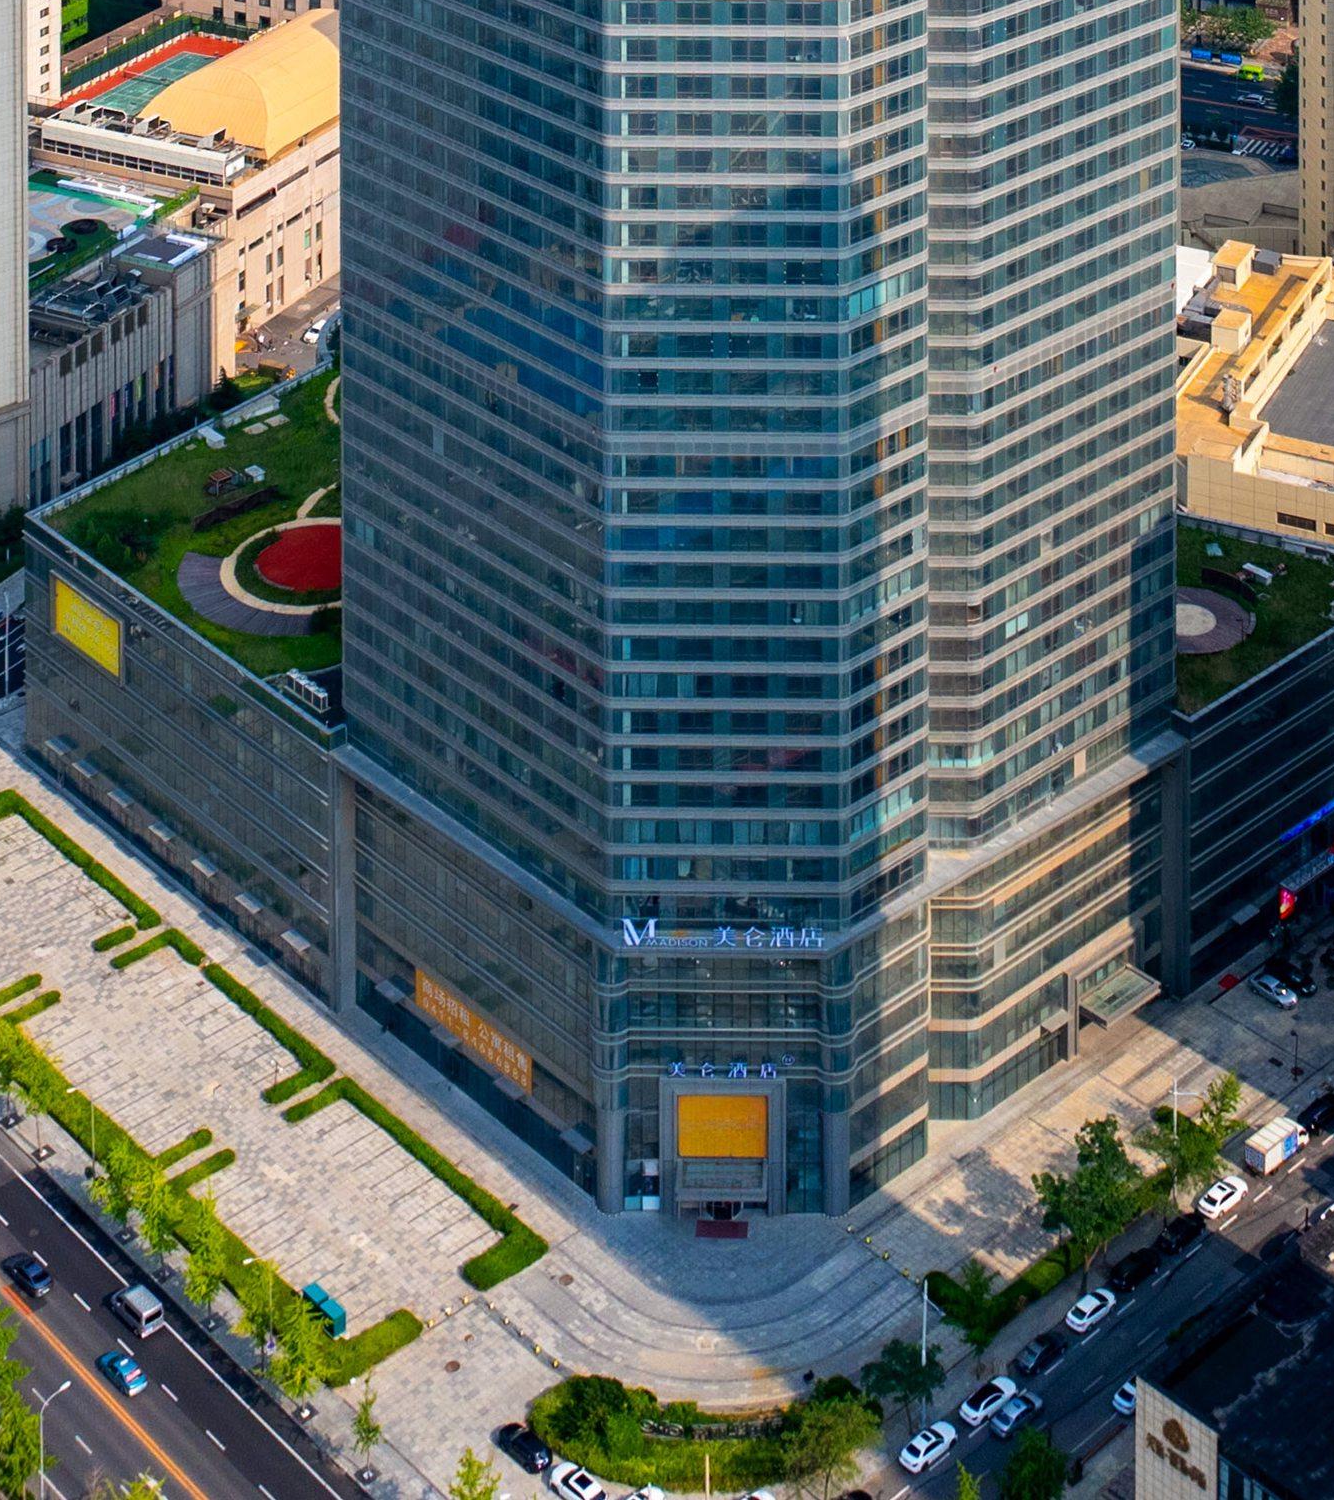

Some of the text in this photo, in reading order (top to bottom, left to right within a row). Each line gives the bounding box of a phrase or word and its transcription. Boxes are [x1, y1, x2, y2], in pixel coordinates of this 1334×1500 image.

[645, 937, 708, 948] MADISON
[713, 926, 826, 948] 美仑酒店
[668, 1061, 777, 1079] 美仑酒店
